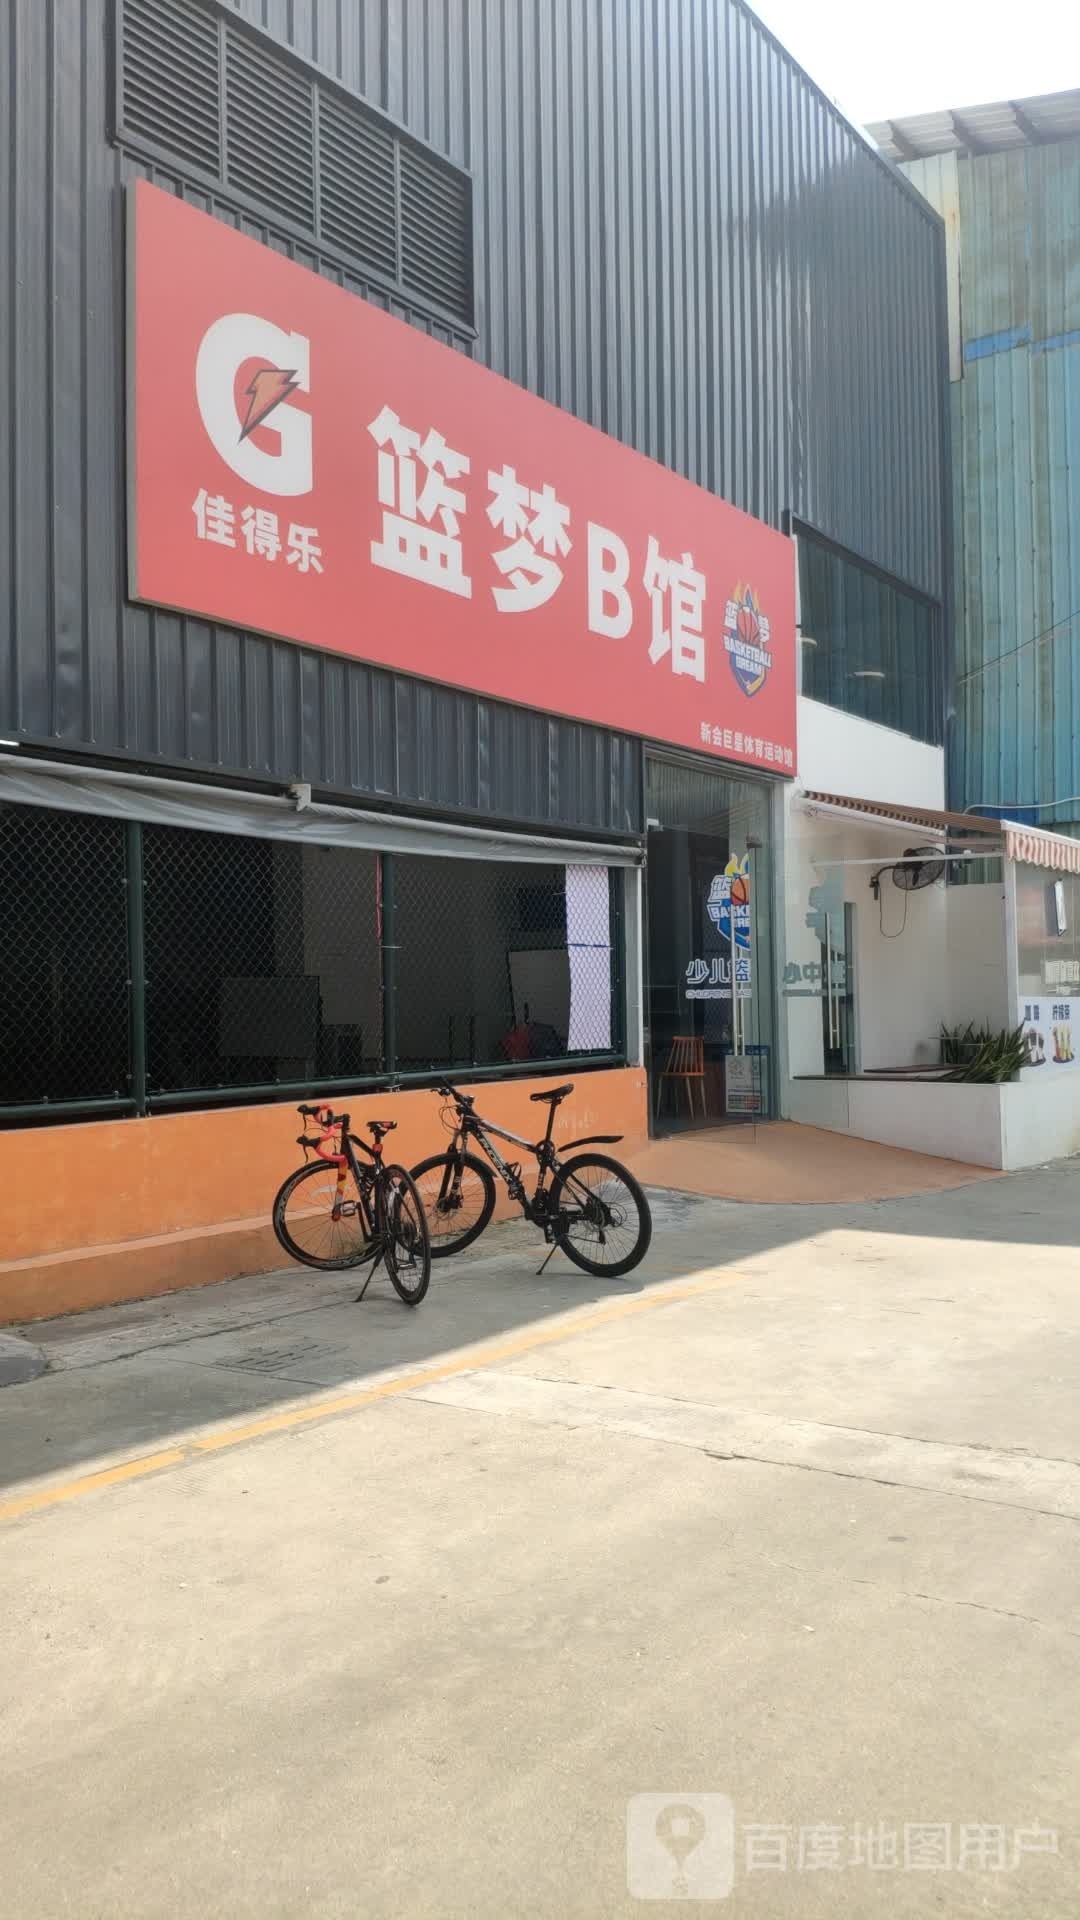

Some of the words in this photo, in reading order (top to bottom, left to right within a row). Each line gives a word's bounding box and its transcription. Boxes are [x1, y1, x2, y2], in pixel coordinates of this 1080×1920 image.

[195, 313, 313, 496] G
[192, 488, 324, 575] 佳得乐
[367, 406, 706, 683] 篮梦B馆
[723, 635, 772, 667] BASKETBALL
[700, 721, 793, 768] 新会巨星体育运动馆
[480, 1137, 513, 1182] PHOENIX
